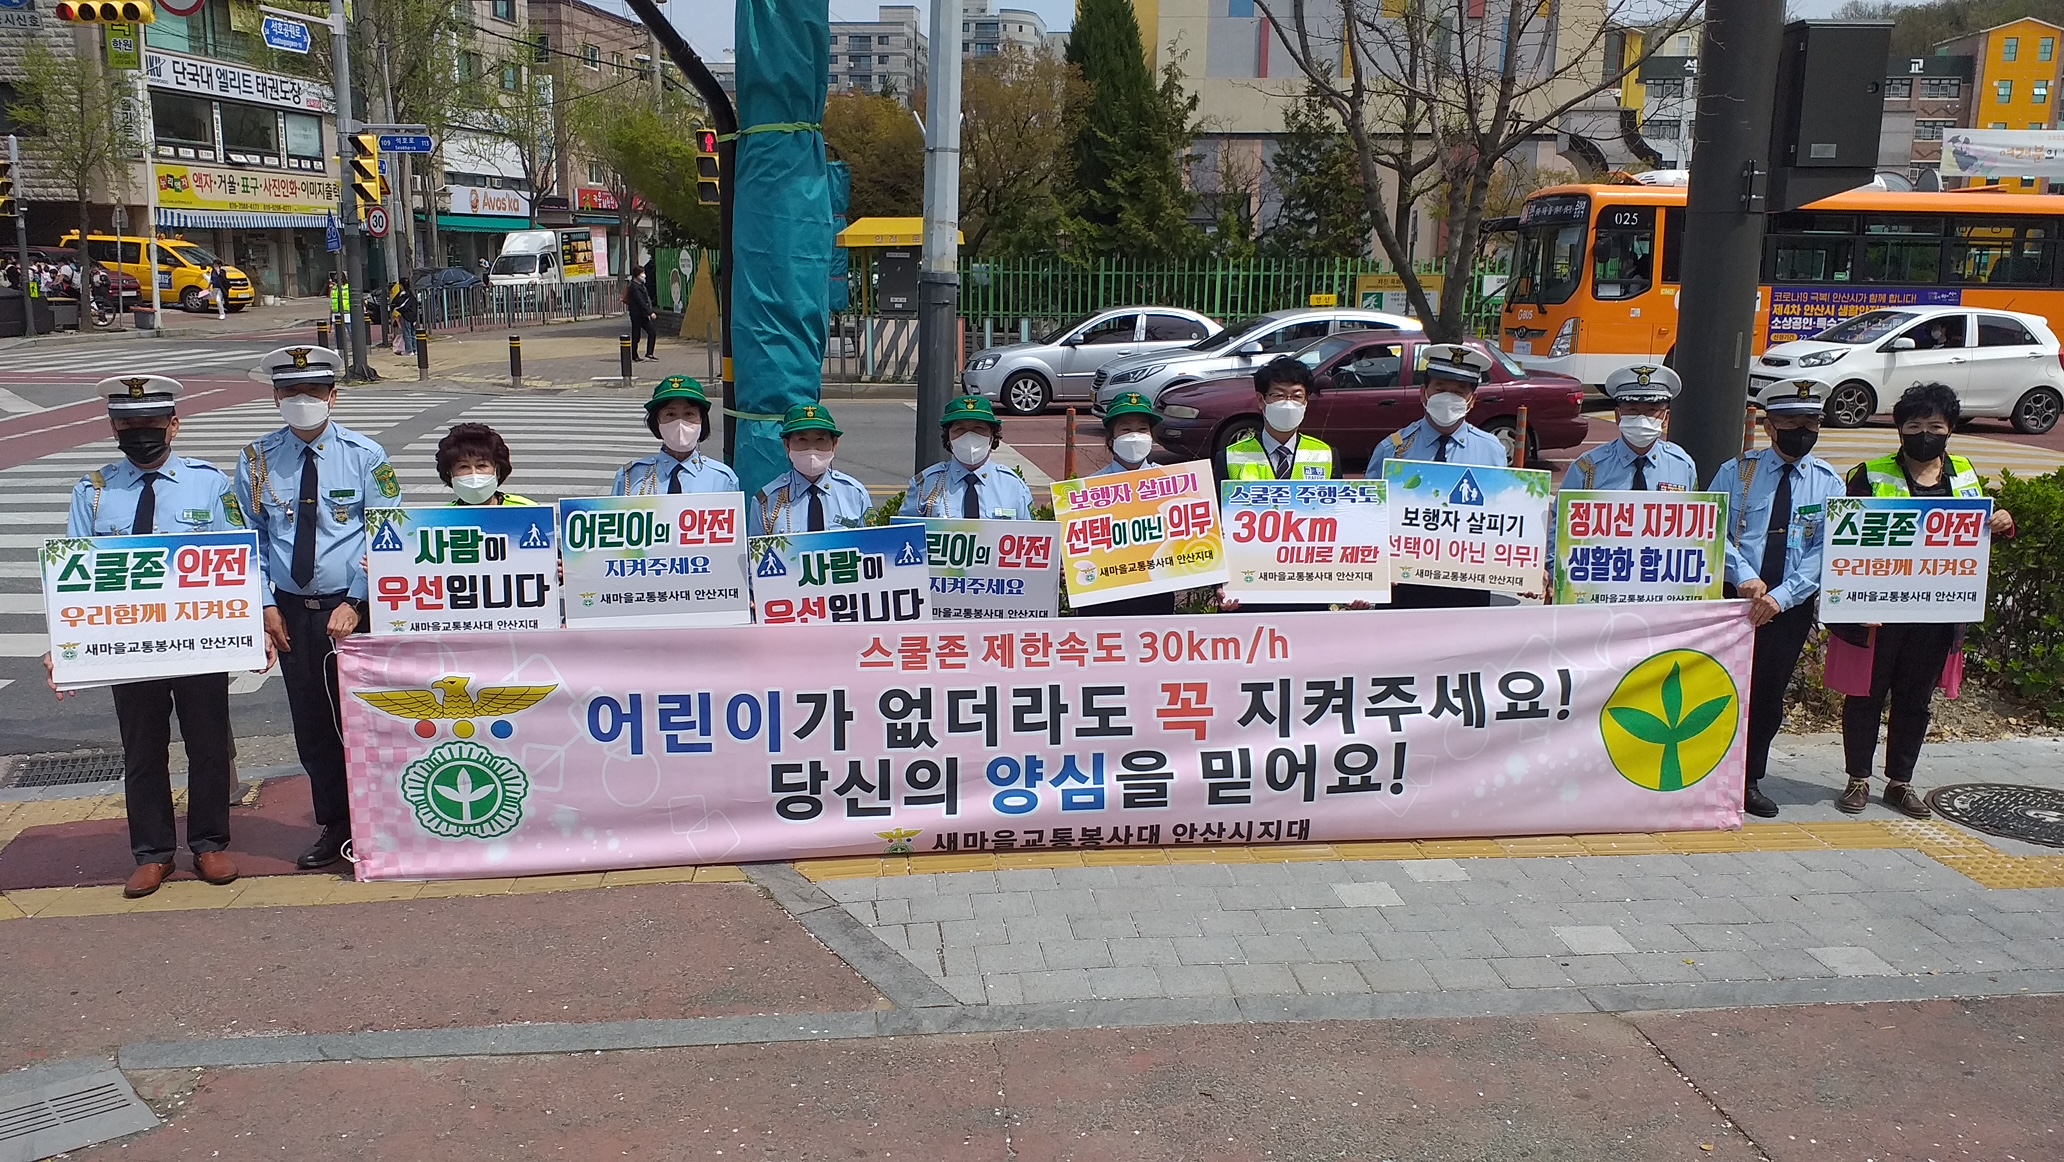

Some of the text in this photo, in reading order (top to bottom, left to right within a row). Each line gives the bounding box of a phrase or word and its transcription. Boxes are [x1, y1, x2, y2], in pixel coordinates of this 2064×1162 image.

[0, 13, 40, 26] 시신호
[111, 39, 133, 51] 학원
[1909, 58, 1924, 73] 교
[172, 60, 213, 90] 단국대
[215, 67, 254, 95] 엘리트
[256, 75, 301, 105] 태권도장
[372, 215, 385, 229] 30
[1614, 213, 1639, 226] 025
[1772, 304, 1801, 316] 제4차
[1804, 304, 1836, 317] 안산시
[1774, 292, 1809, 302] 코로나19
[1811, 292, 1831, 302] 극복!
[1832, 293, 1867, 303] 안산시가
[1869, 294, 1887, 304] 함께
[1889, 294, 1917, 304] 합니다!
[1069, 473, 1198, 510] 보행자 살피기
[1229, 486, 1378, 504] 스쿨존 주행속도
[568, 509, 735, 549] 어린이의 안전
[1066, 501, 1213, 555] 선택이 아닌 의무
[1232, 511, 1338, 543] 30km
[1401, 507, 1524, 538] 보행자 살피기
[1570, 502, 1715, 539] 정지선 지키기!
[1831, 511, 1983, 547] 스쿨존 안전
[414, 529, 507, 565] 사람이
[926, 533, 1052, 568] 린이의 안전
[1276, 545, 1380, 564] 이내로 제한
[1389, 535, 1539, 568] 선택이 아닌 의무!
[56, 547, 248, 593] 스쿨존 안전
[604, 556, 711, 578] 지켜주세요
[798, 551, 884, 587] 사람이
[1100, 550, 1214, 577] 새마을교통봉사대 안산지대
[1258, 571, 1373, 582] 새마을교통봉사대 안산지대
[1415, 568, 1524, 587] 새마을교통봉사대 안산지대
[1568, 546, 1711, 584] 생활화 합시다.
[1831, 558, 1978, 577] 우리함께 지켜요
[377, 574, 551, 611] 우선입니다
[600, 588, 739, 605] 새마을교통봉사대 안산지대
[929, 577, 1025, 595] 지켜주세요
[1846, 591, 1977, 603] 새마을교통봉사대 안산지대
[60, 599, 250, 628] 우리함께 지켜요
[764, 588, 924, 624] 우선입니다
[932, 608, 1049, 619] 마을교통봉사대 안산지대
[409, 619, 539, 632] 새마을교통봉사대 안산지대
[84, 635, 253, 657] 새마을교통봉사대 안산지대
[859, 625, 1291, 671] 스쿨존 제한속도 30km/h
[586, 668, 1572, 755] 어린이가 없더라도 꼭 지켜주세요!
[769, 741, 1407, 821] 당신의 양심을 믿어요!
[931, 818, 1312, 853] 새마을교통봉사대 안산시지대
